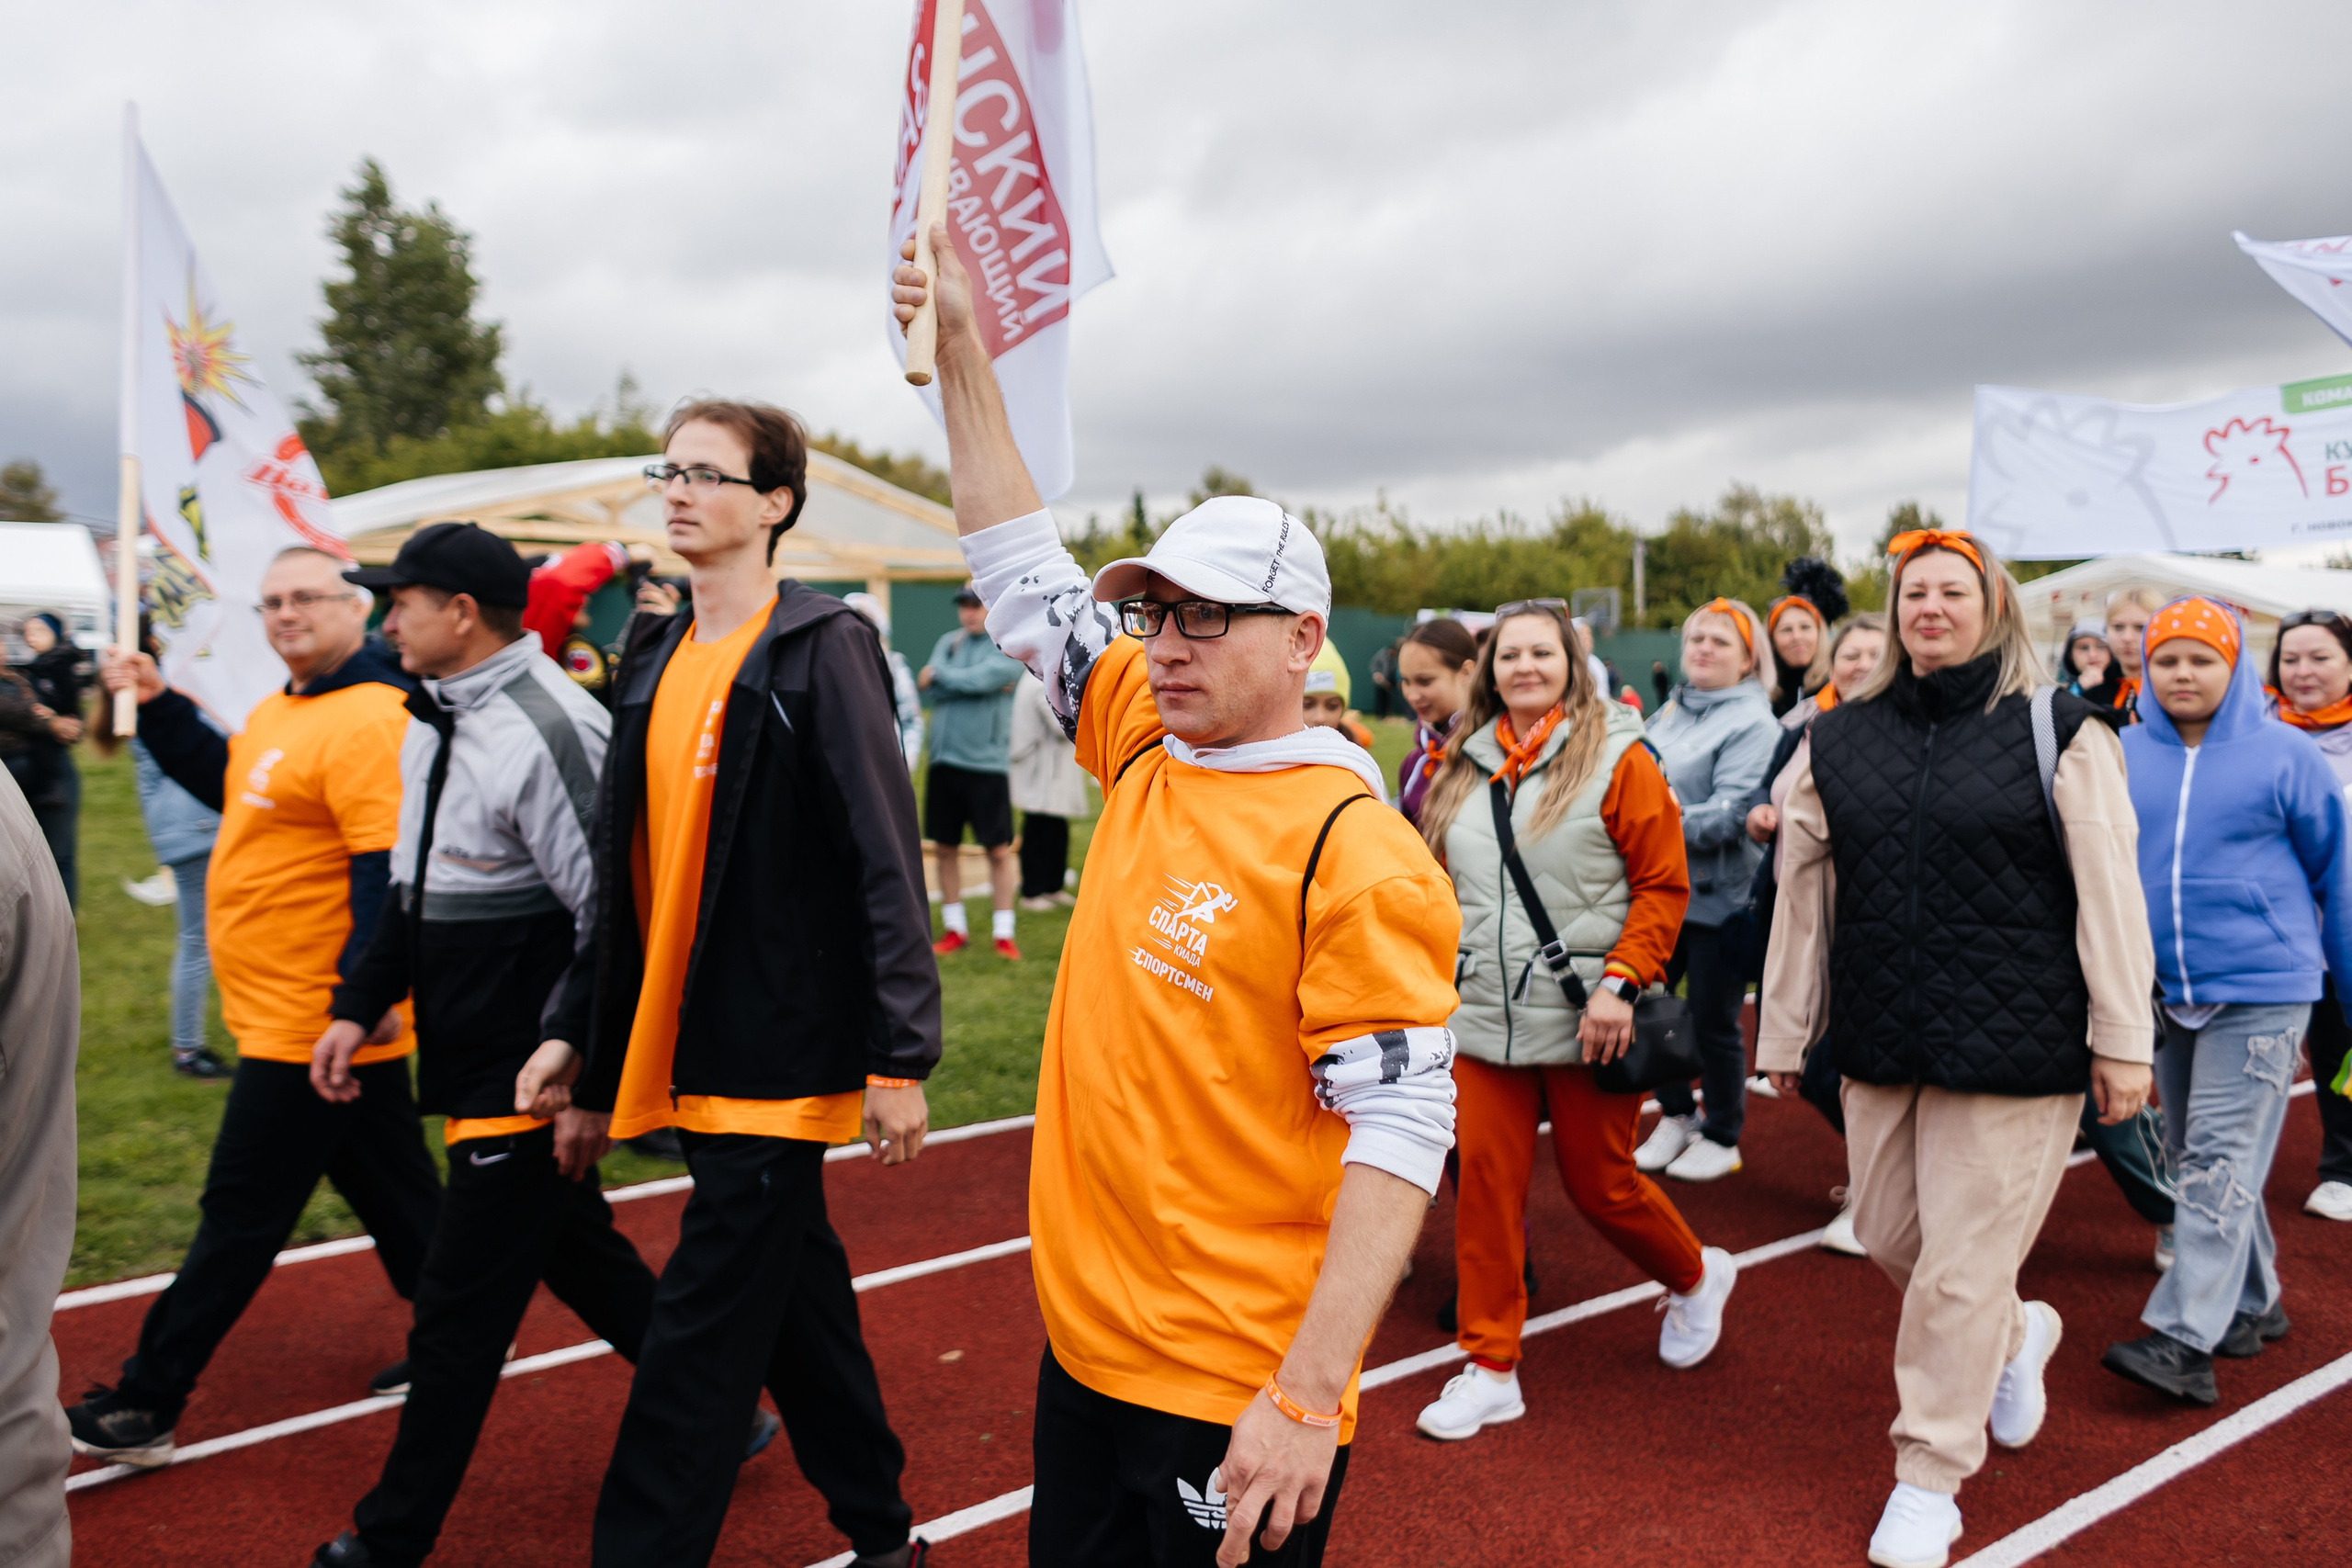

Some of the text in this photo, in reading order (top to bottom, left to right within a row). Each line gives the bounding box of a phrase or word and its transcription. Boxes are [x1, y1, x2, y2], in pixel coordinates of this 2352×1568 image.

[948, 157, 1027, 343] ВАЮЩИЙ
[1261, 558, 1281, 593] FORGET
[1275, 541, 1285, 558] THE
[1280, 520, 1290, 543] RULES
[1148, 905, 1208, 957] СПАРТА
[1173, 943, 1202, 968] КИАДА
[1133, 947, 1215, 1003] СПОРТСМЕН
